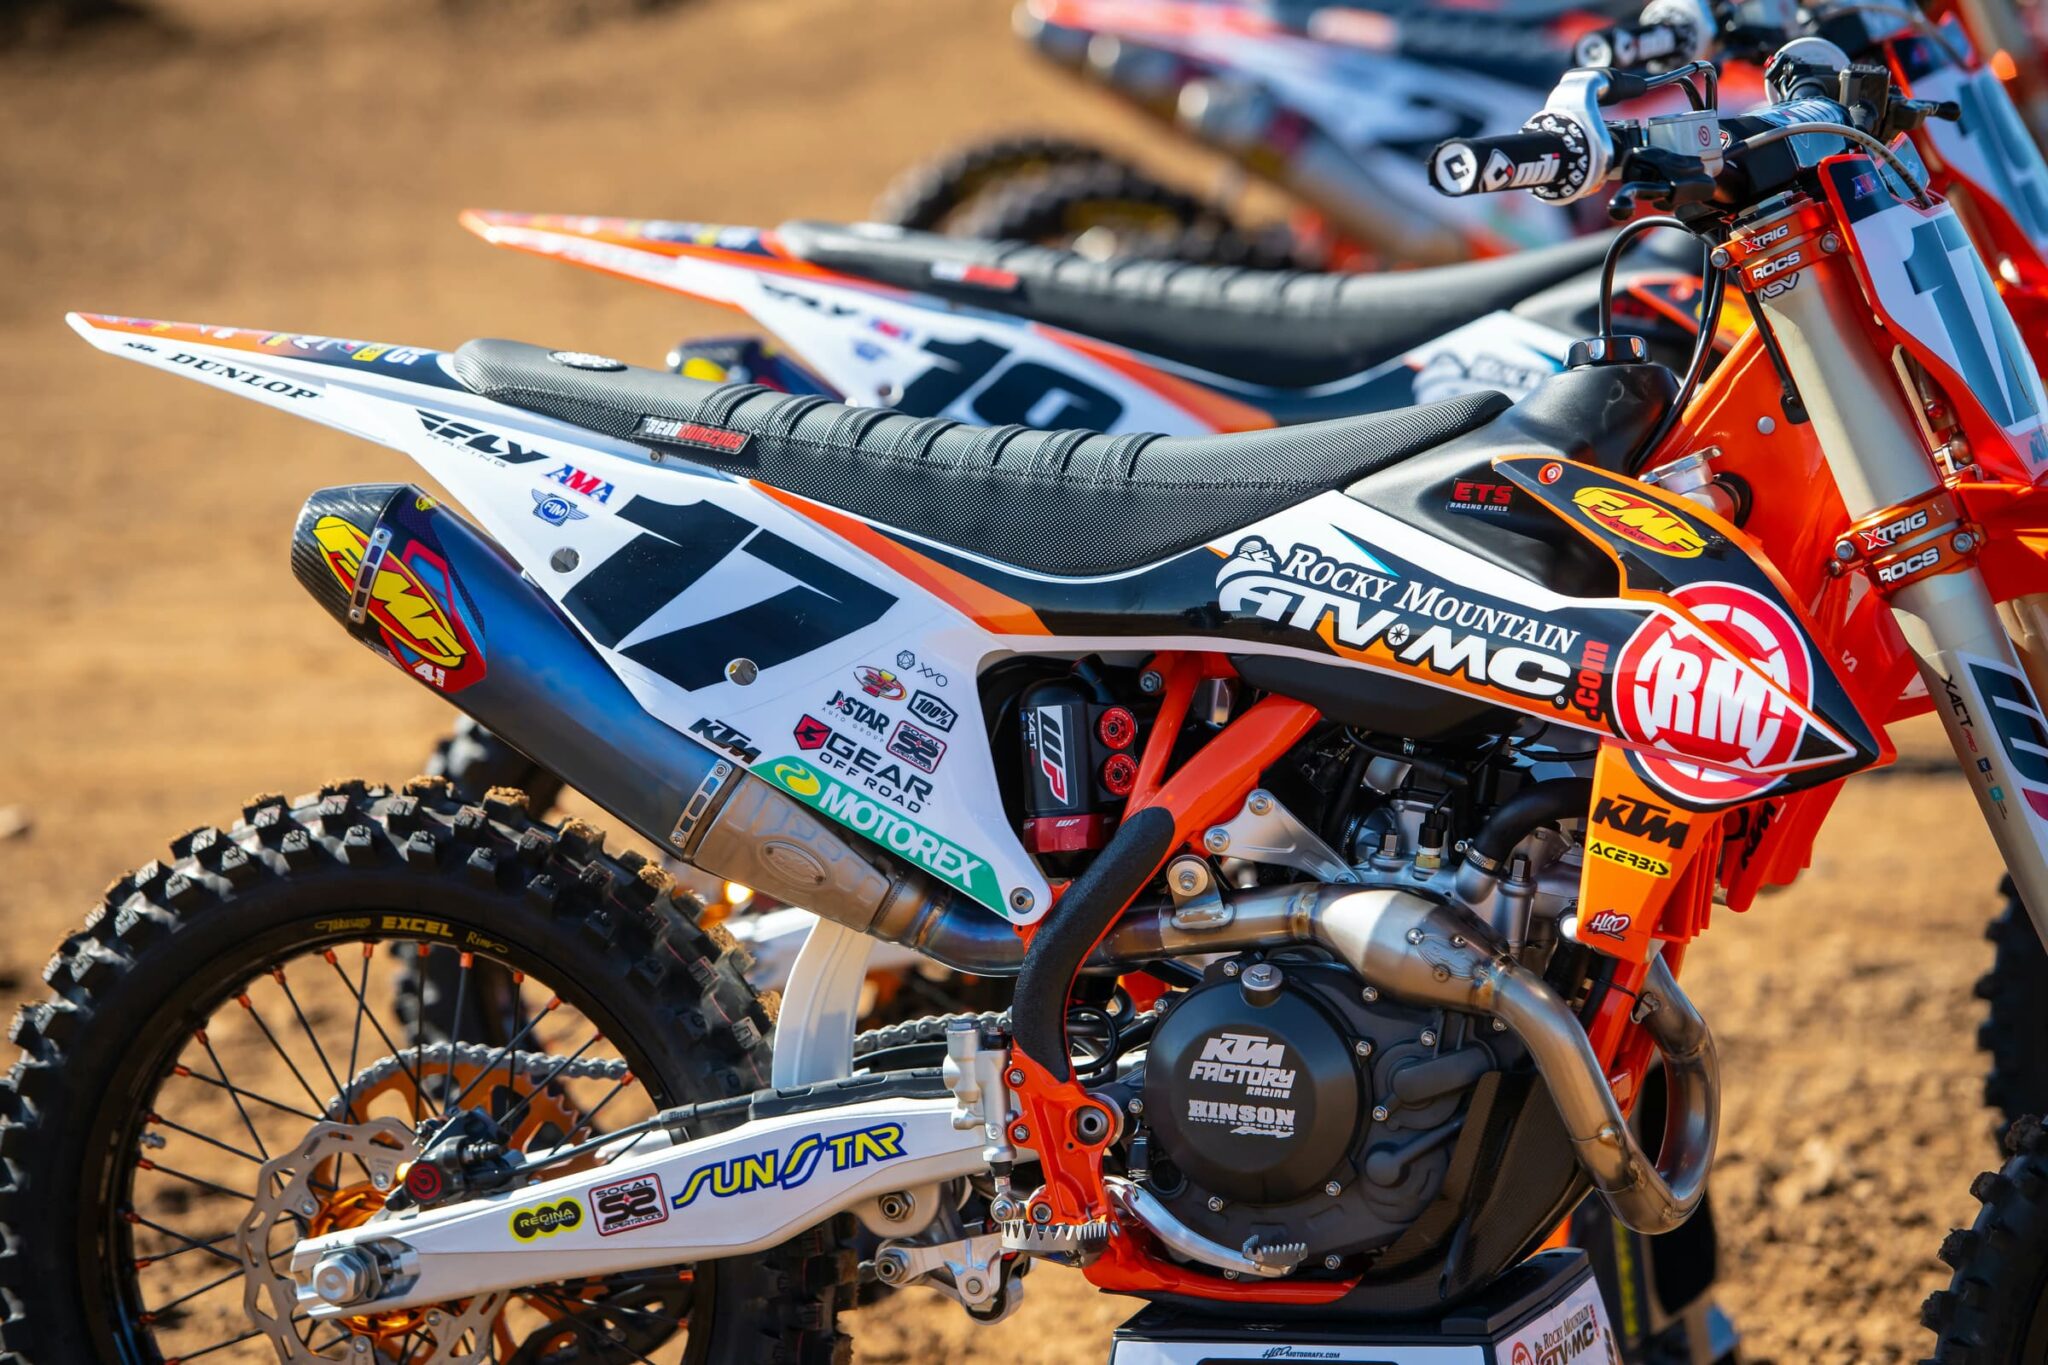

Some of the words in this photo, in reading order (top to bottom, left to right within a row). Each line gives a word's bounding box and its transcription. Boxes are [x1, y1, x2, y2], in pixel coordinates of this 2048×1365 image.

[1740, 224, 1789, 254] XTRIG
[1752, 251, 1801, 281] ROCS
[166, 353, 320, 400] DUNLOP
[416, 409, 550, 464] FLY
[426, 433, 507, 468] RACING
[542, 464, 616, 504] AMA
[1453, 481, 1513, 504] ETS
[545, 503, 566, 517] FIM
[1450, 502, 1482, 511] RACING
[1483, 504, 1508, 512] FUELS
[1572, 488, 1708, 551] FMF
[1859, 510, 1928, 551] XTRIG
[1878, 548, 1939, 582] ROCS
[312, 524, 467, 658] FMF
[561, 494, 899, 692] 17
[1281, 549, 1397, 602] ROCKY
[1394, 581, 1581, 654] MOUNTAIN
[915, 699, 951, 725] 100%
[1646, 643, 1793, 767] RMC
[1940, 674, 1973, 728] XACT
[688, 717, 762, 764] KTM
[1027, 712, 1037, 749] XACT
[820, 752, 859, 776] OFF
[864, 776, 921, 814] ROAD
[826, 732, 933, 803] GEAR
[819, 783, 982, 888] MOTOREX
[1592, 794, 1690, 849] KTM
[381, 916, 453, 937] EXCEL
[1200, 1033, 1285, 1067] KTM
[1189, 1061, 1296, 1088] FACTORY
[1246, 1086, 1290, 1098] RACING
[1188, 1100, 1295, 1125] HINSON
[596, 1180, 653, 1198] SOCAL
[520, 1209, 573, 1227] REGINA
[544, 1215, 575, 1225] CHAIN
